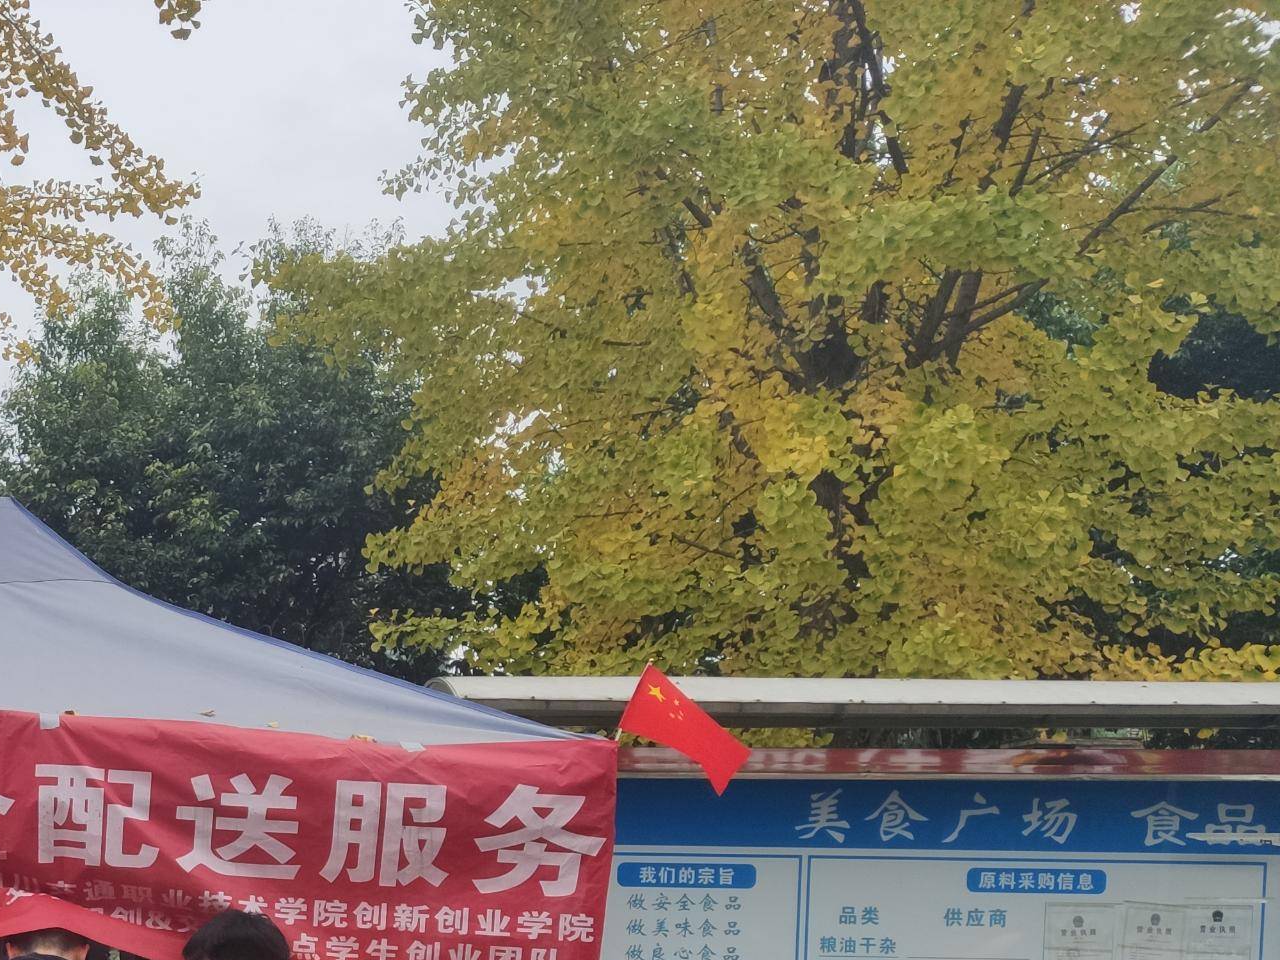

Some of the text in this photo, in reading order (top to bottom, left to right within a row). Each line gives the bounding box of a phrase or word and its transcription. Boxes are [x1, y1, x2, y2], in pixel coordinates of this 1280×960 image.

[795, 788, 1079, 844] 美食广场
[639, 866, 735, 886] 我们的宗旨
[978, 872, 1095, 892] 原料采购信息
[626, 893, 742, 912] 做安全食品
[839, 906, 880, 925] 品类
[944, 908, 1008, 928] 供应商
[625, 917, 741, 938] 做美味食品
[819, 936, 897, 954] 粮油干杂
